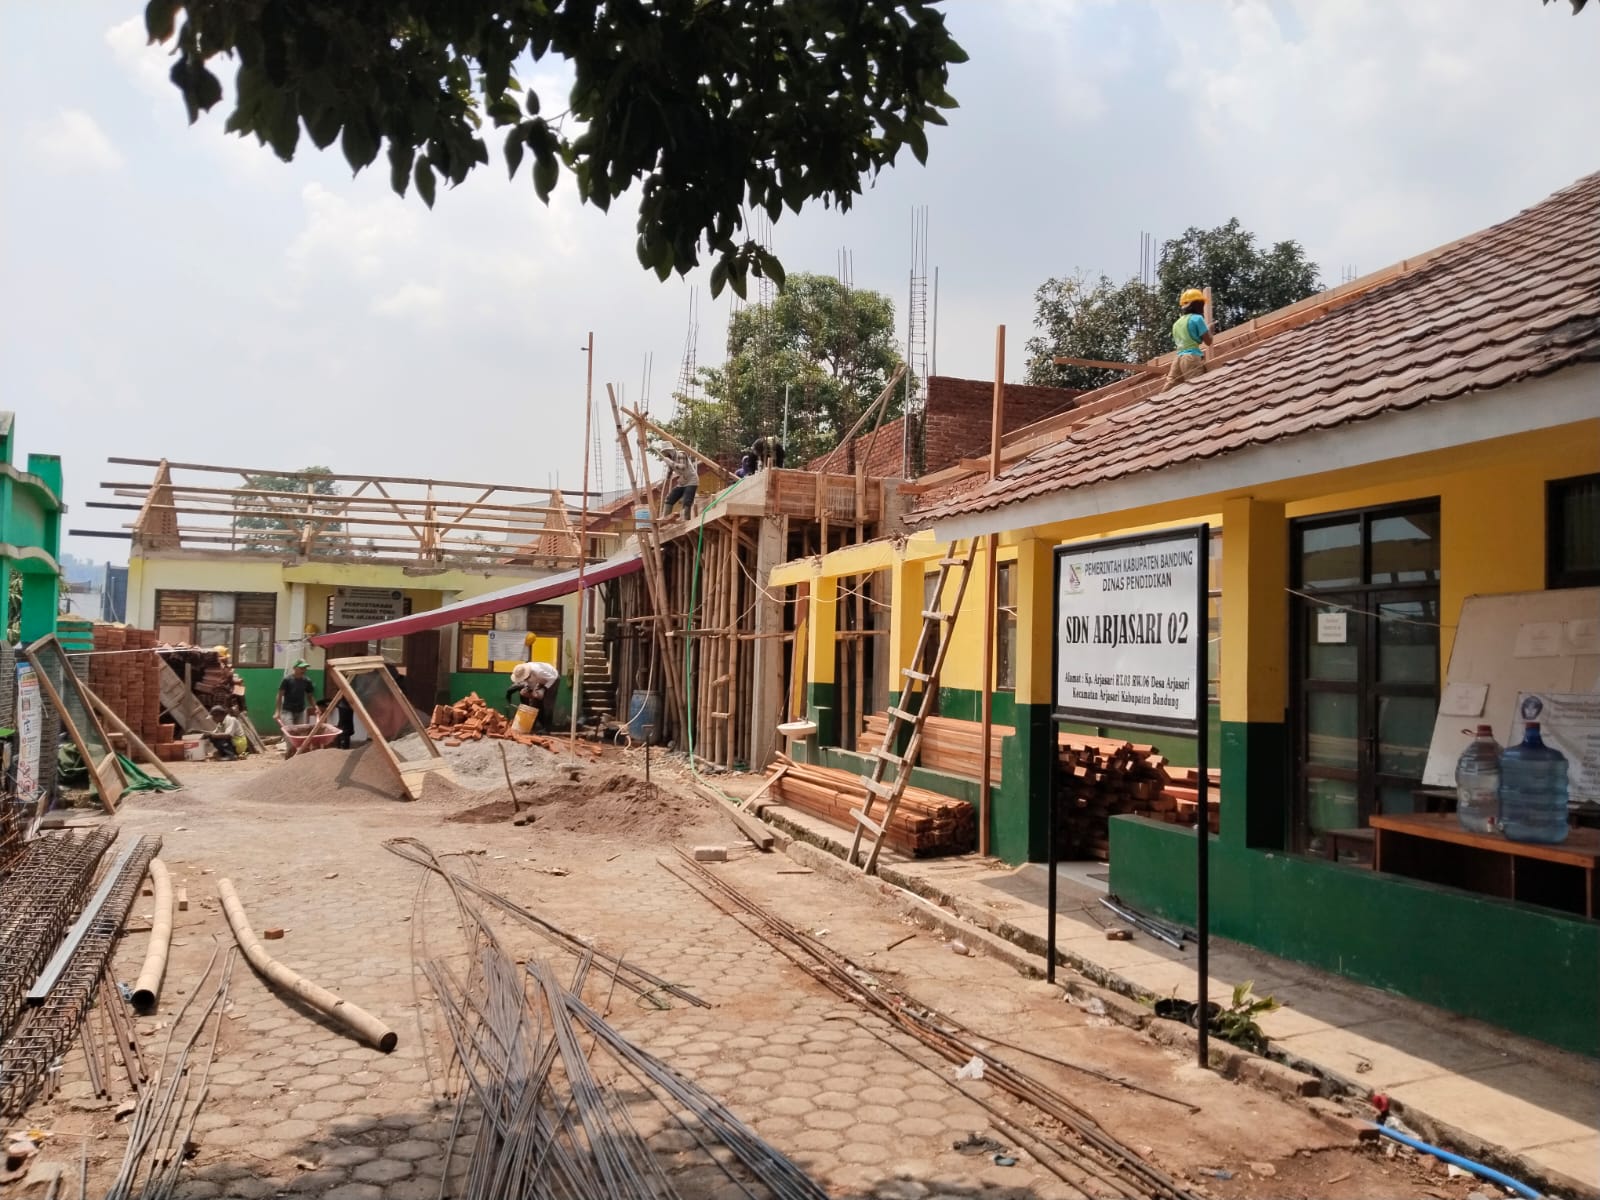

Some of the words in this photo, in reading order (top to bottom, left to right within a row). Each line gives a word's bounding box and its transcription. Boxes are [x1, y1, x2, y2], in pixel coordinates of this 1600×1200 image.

[1084, 558, 1122, 576] PEMERINTAH
[1123, 554, 1159, 573] KABUPATEN
[1160, 550, 1193, 569] BANDUNG
[1102, 578, 1125, 592] DINAS
[1126, 572, 1172, 590] PENDIDIKAN
[1066, 615, 1089, 644] SDN
[1093, 612, 1162, 648] ARJASARI
[1167, 611, 1189, 644] 02
[1094, 673, 1115, 687] Arjasari
[1151, 676, 1165, 688] Desa
[1166, 677, 1190, 692] Arjasari
[1072, 687, 1098, 700] Kecamatan
[1100, 688, 1120, 703] Arjasari
[1121, 691, 1151, 706] Kabupaten
[1152, 693, 1179, 709] Bandung
